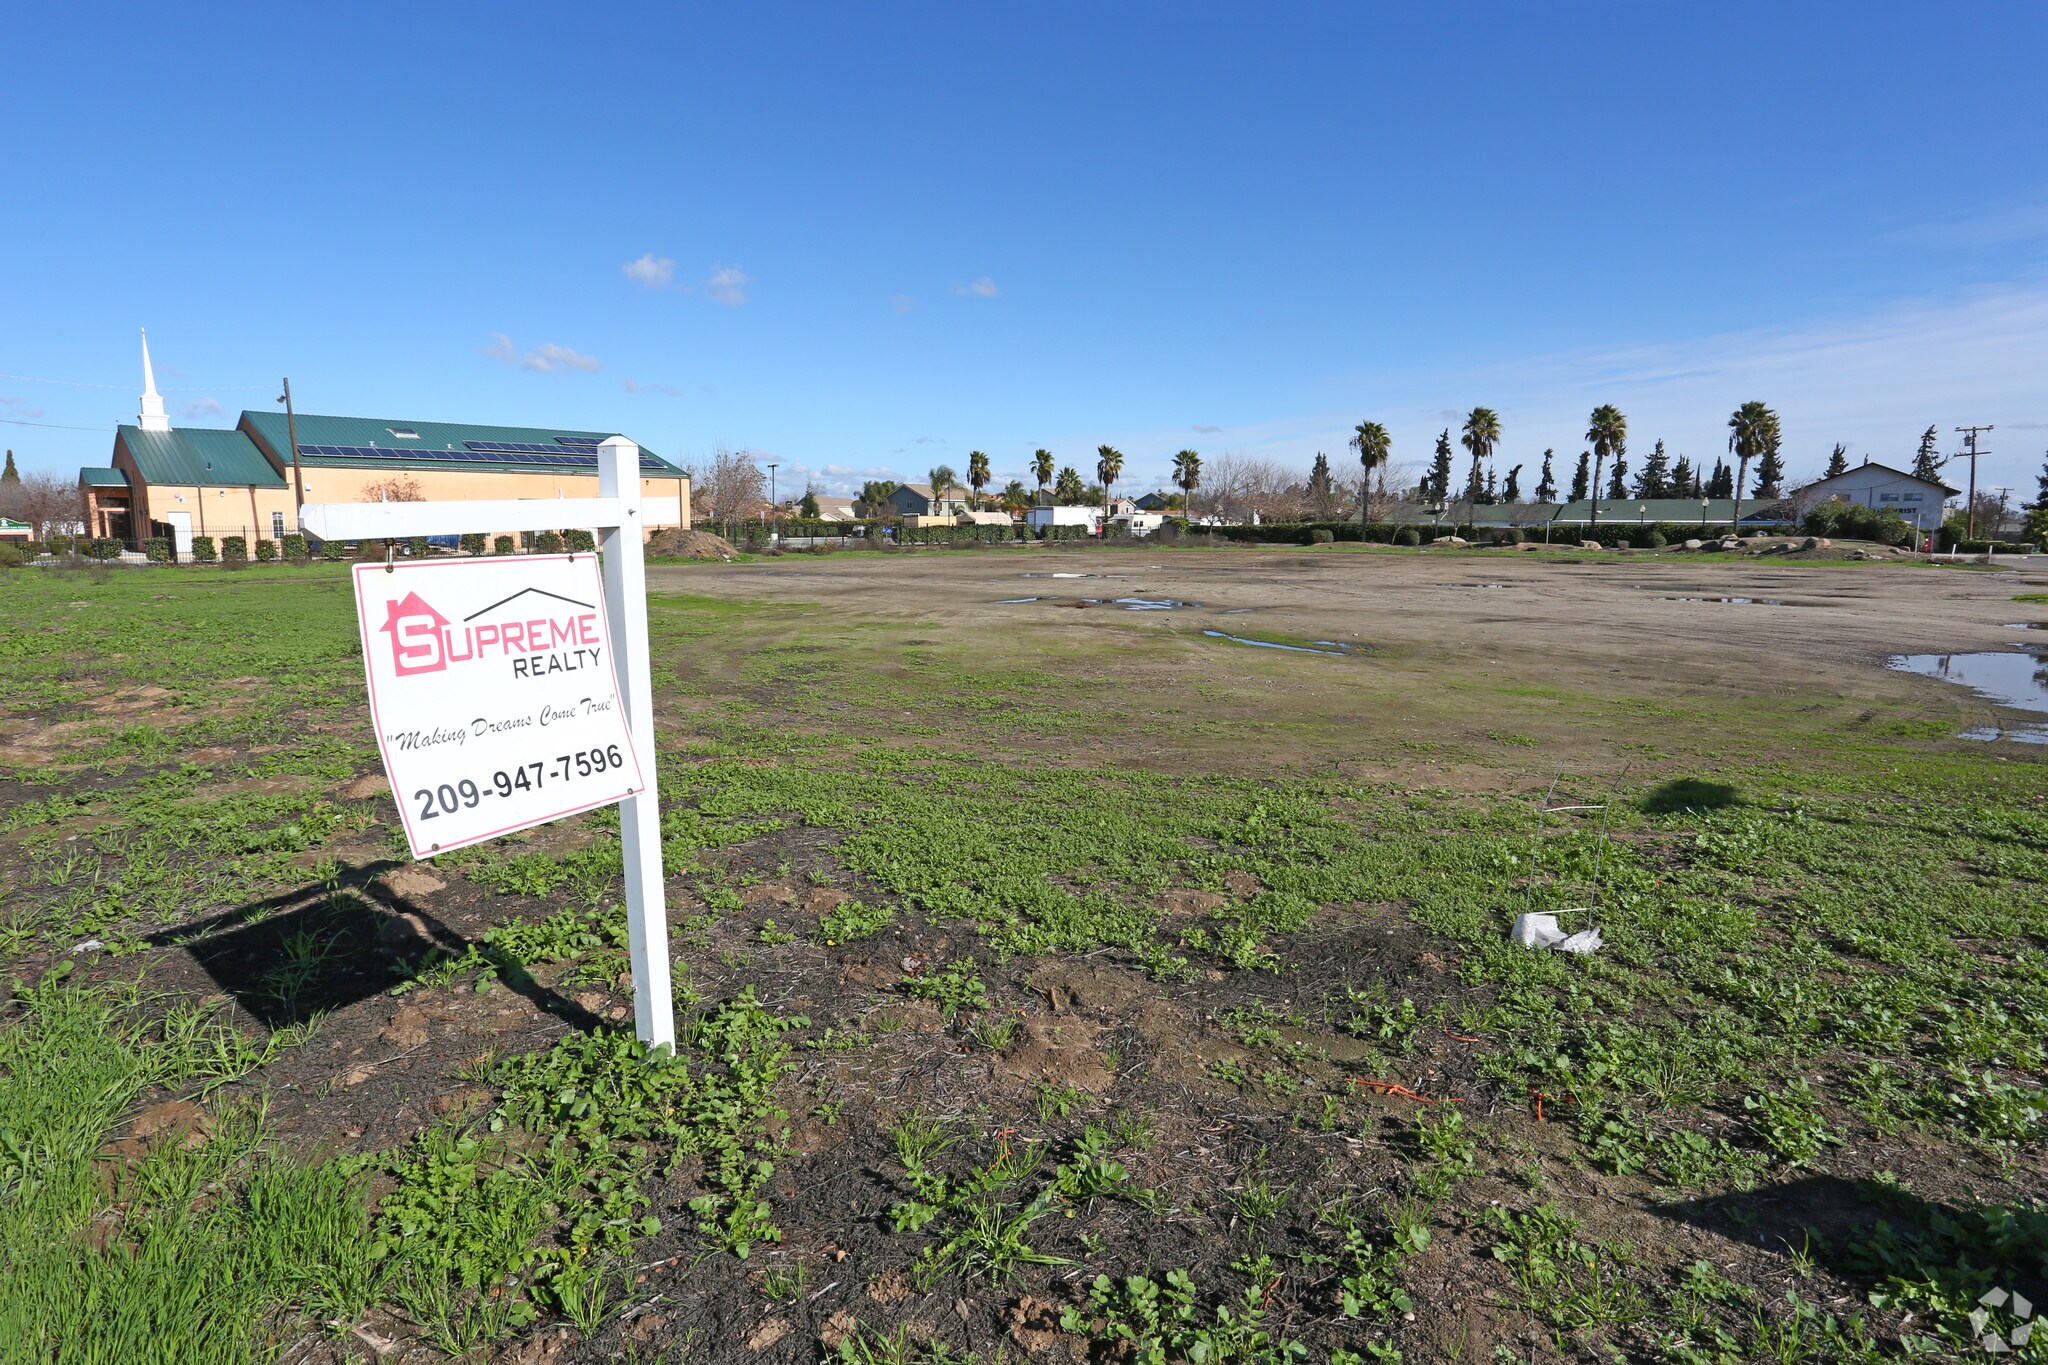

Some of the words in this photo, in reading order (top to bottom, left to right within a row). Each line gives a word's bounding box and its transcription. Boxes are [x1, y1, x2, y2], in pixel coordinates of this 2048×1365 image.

[396, 614, 600, 669] SUPREME
[514, 648, 601, 679] REALTY
[386, 728, 466, 751] "Making
[471, 717, 532, 737] Dreams
[539, 705, 577, 726] Come
[580, 693, 615, 715] True"
[414, 744, 623, 820] 209-947-7596
